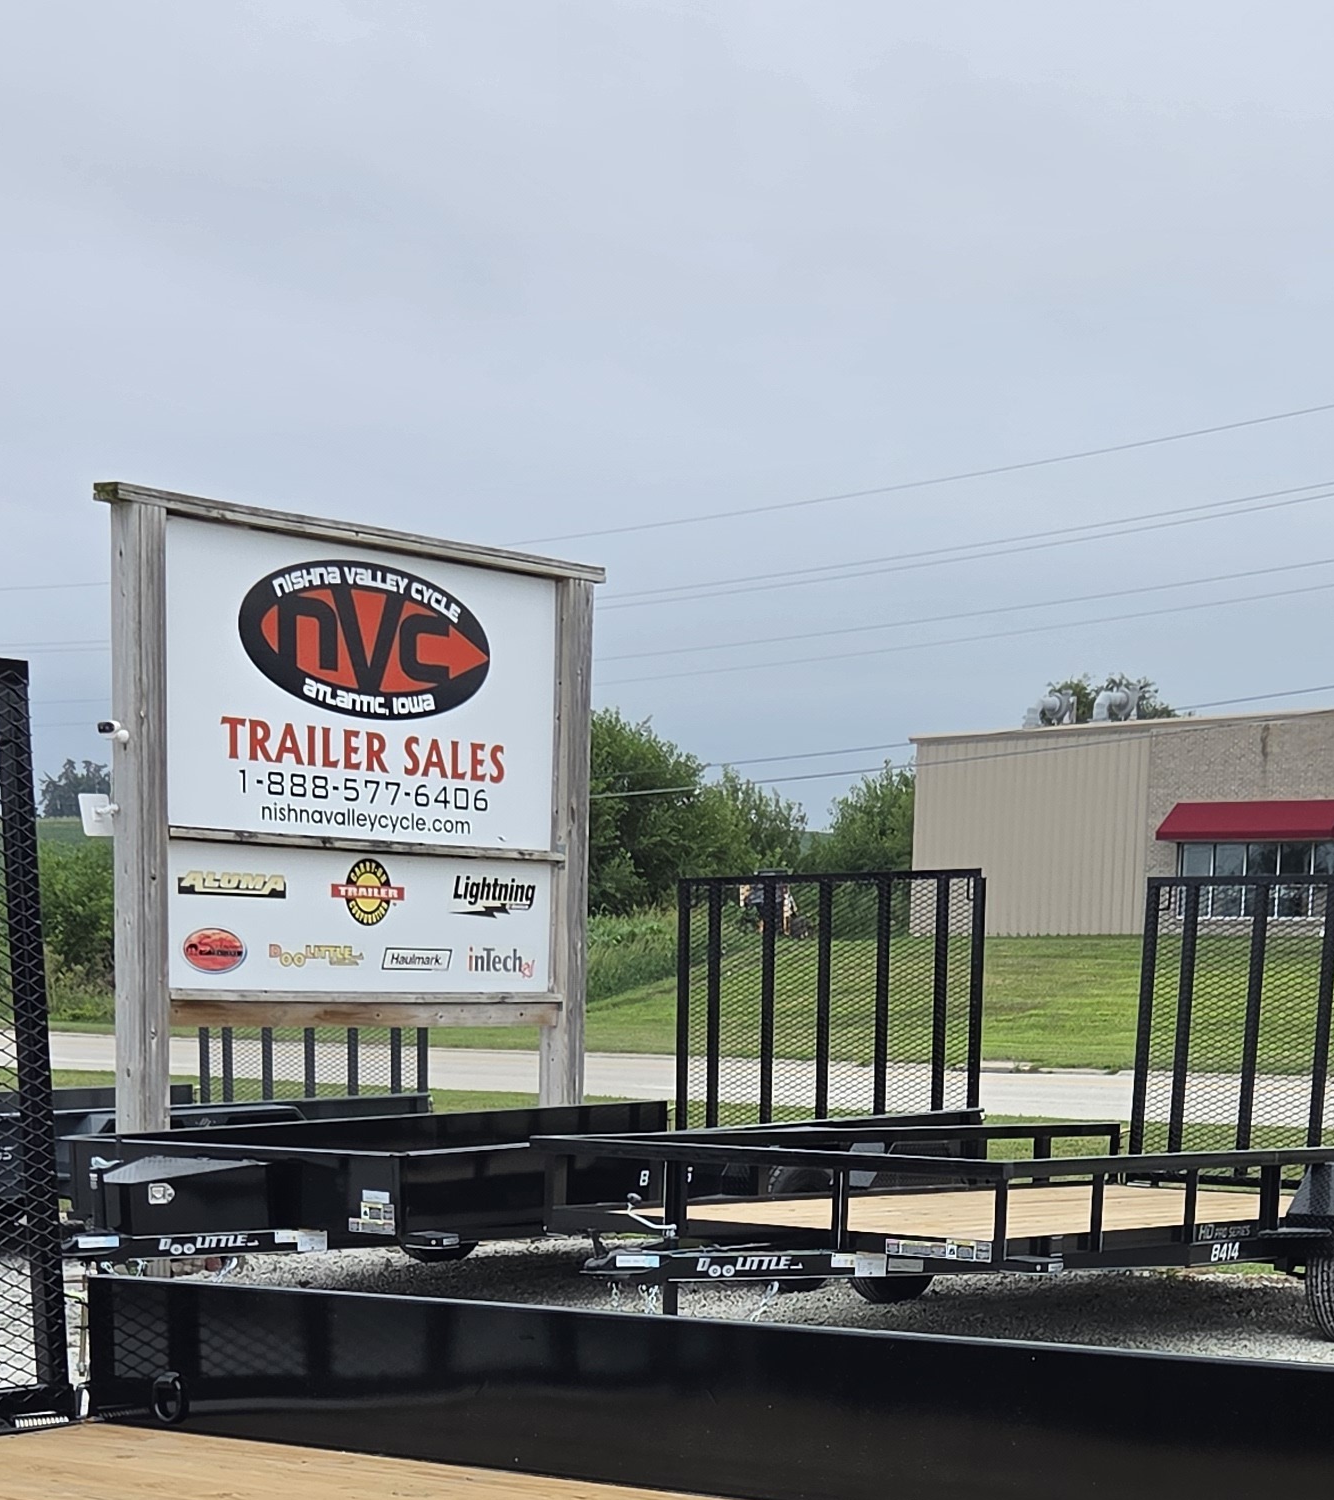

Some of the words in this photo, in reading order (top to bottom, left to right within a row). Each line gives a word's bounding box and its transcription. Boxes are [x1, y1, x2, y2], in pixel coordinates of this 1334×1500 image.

[410, 581, 461, 624] CYCLE
[220, 715, 389, 774] TRAILER
[403, 735, 505, 784] SALES
[238, 769, 489, 812] 1-888-577-6406
[261, 801, 471, 835] nishnavalleycycle.com
[180, 870, 285, 895] ALUMA
[338, 886, 399, 898] TRAILER
[453, 875, 536, 911] Lightning
[390, 953, 441, 966] Haulmark
[468, 946, 523, 972] inTech
[158, 1234, 249, 1255] DOOLITTLE
[1211, 1242, 1240, 1262] 8414
[696, 1256, 792, 1277] DOOLITTLE
